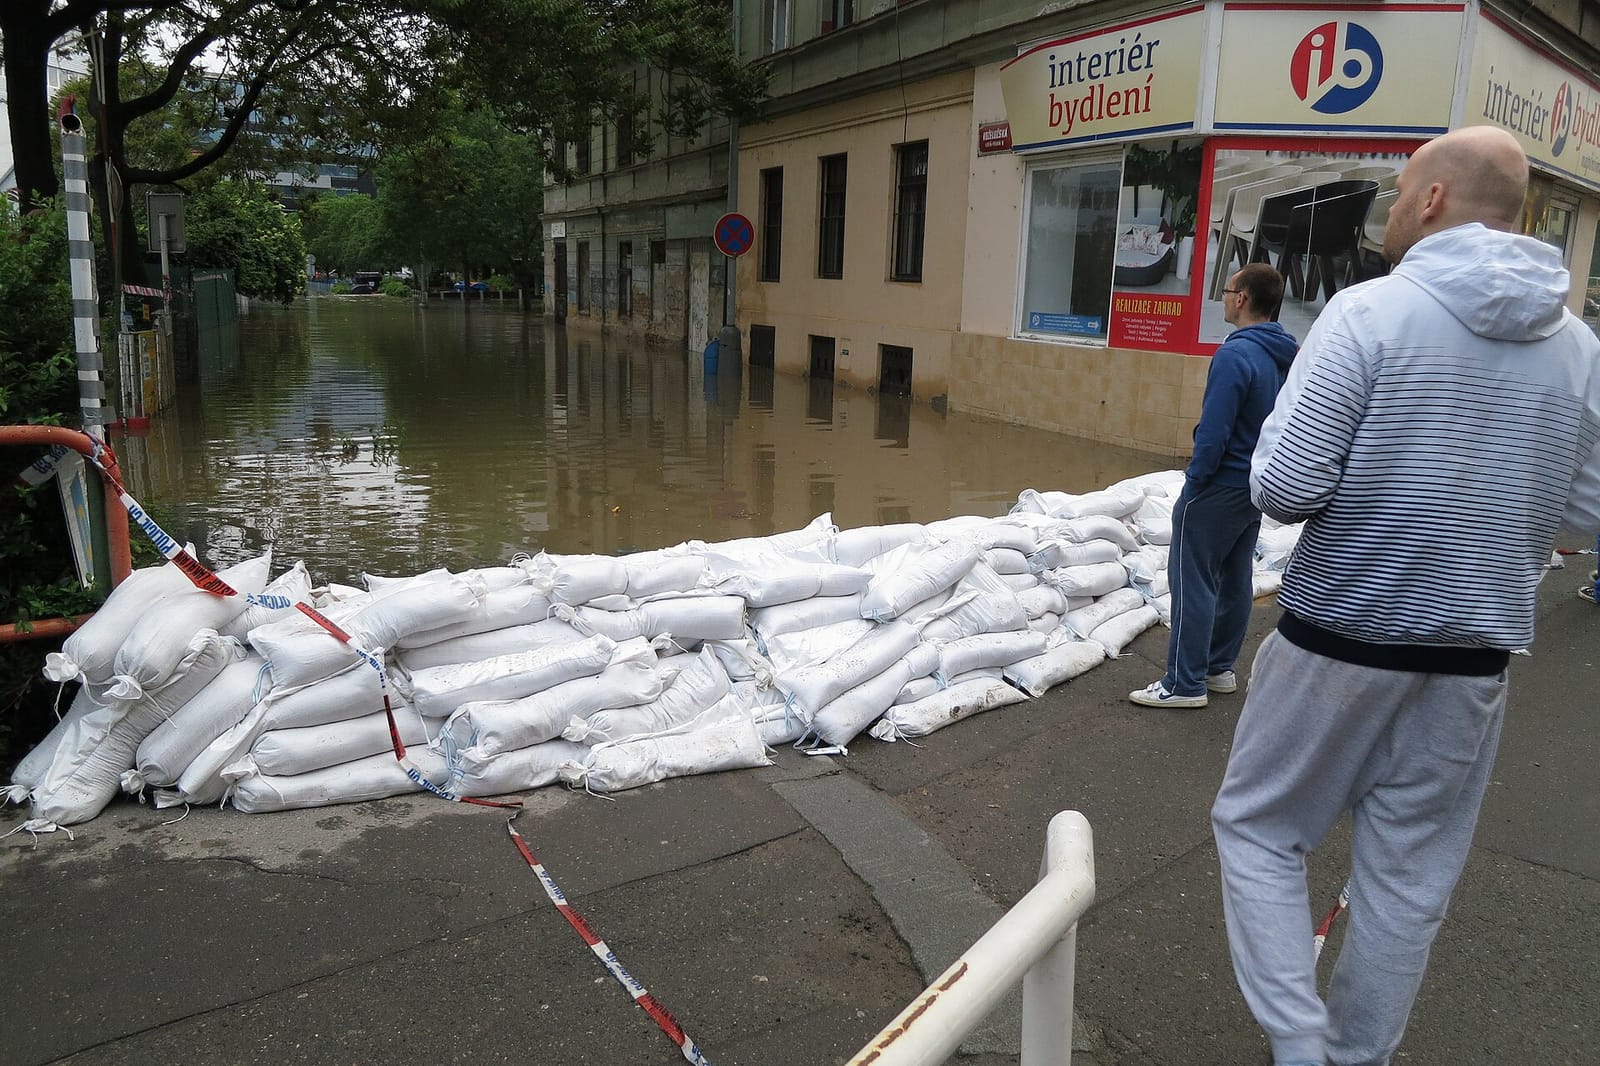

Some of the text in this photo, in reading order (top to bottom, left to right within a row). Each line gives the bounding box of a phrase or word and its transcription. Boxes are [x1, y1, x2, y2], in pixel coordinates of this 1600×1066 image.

[1048, 32, 1160, 89] interiér
[1048, 73, 1154, 136] bydlení
[1483, 65, 1549, 142] interiér
[1115, 298, 1182, 316] REALIZACE ZAHRAD
